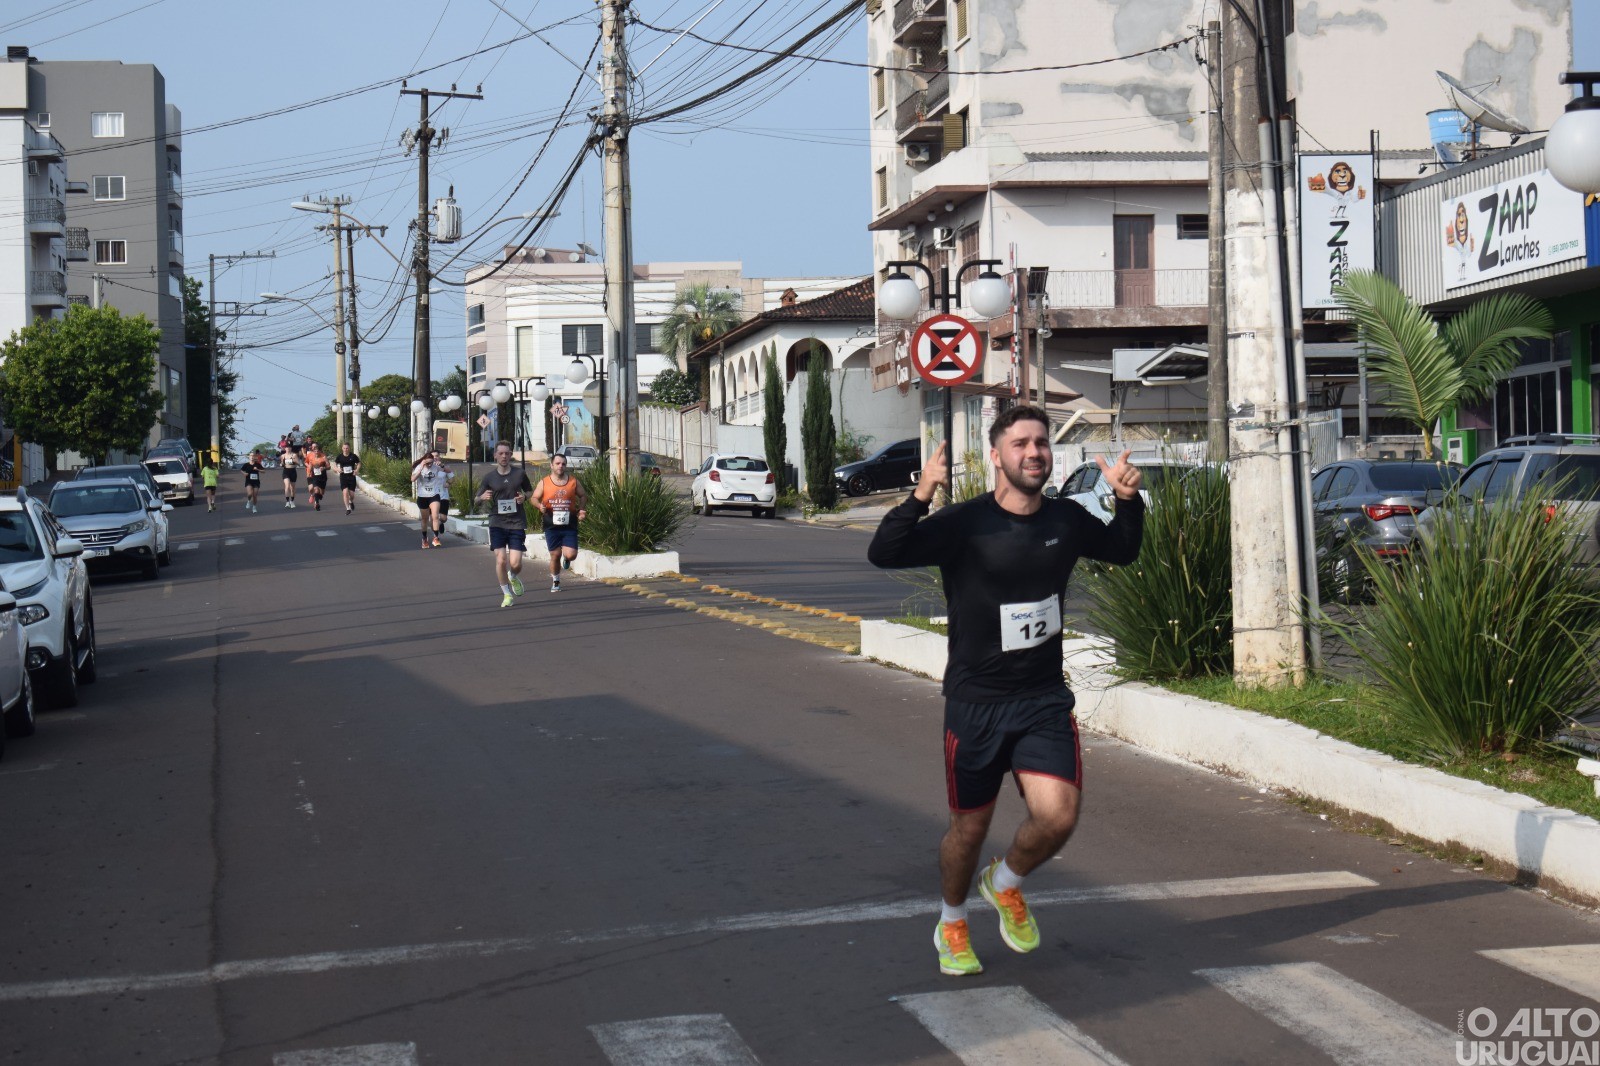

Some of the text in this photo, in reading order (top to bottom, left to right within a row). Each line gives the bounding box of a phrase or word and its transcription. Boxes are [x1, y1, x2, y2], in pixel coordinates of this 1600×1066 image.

[1478, 182, 1538, 272] ZAAP
[1500, 234, 1540, 267] Lanches
[1011, 611, 1034, 621] Sesc
[1019, 620, 1047, 640] 12
